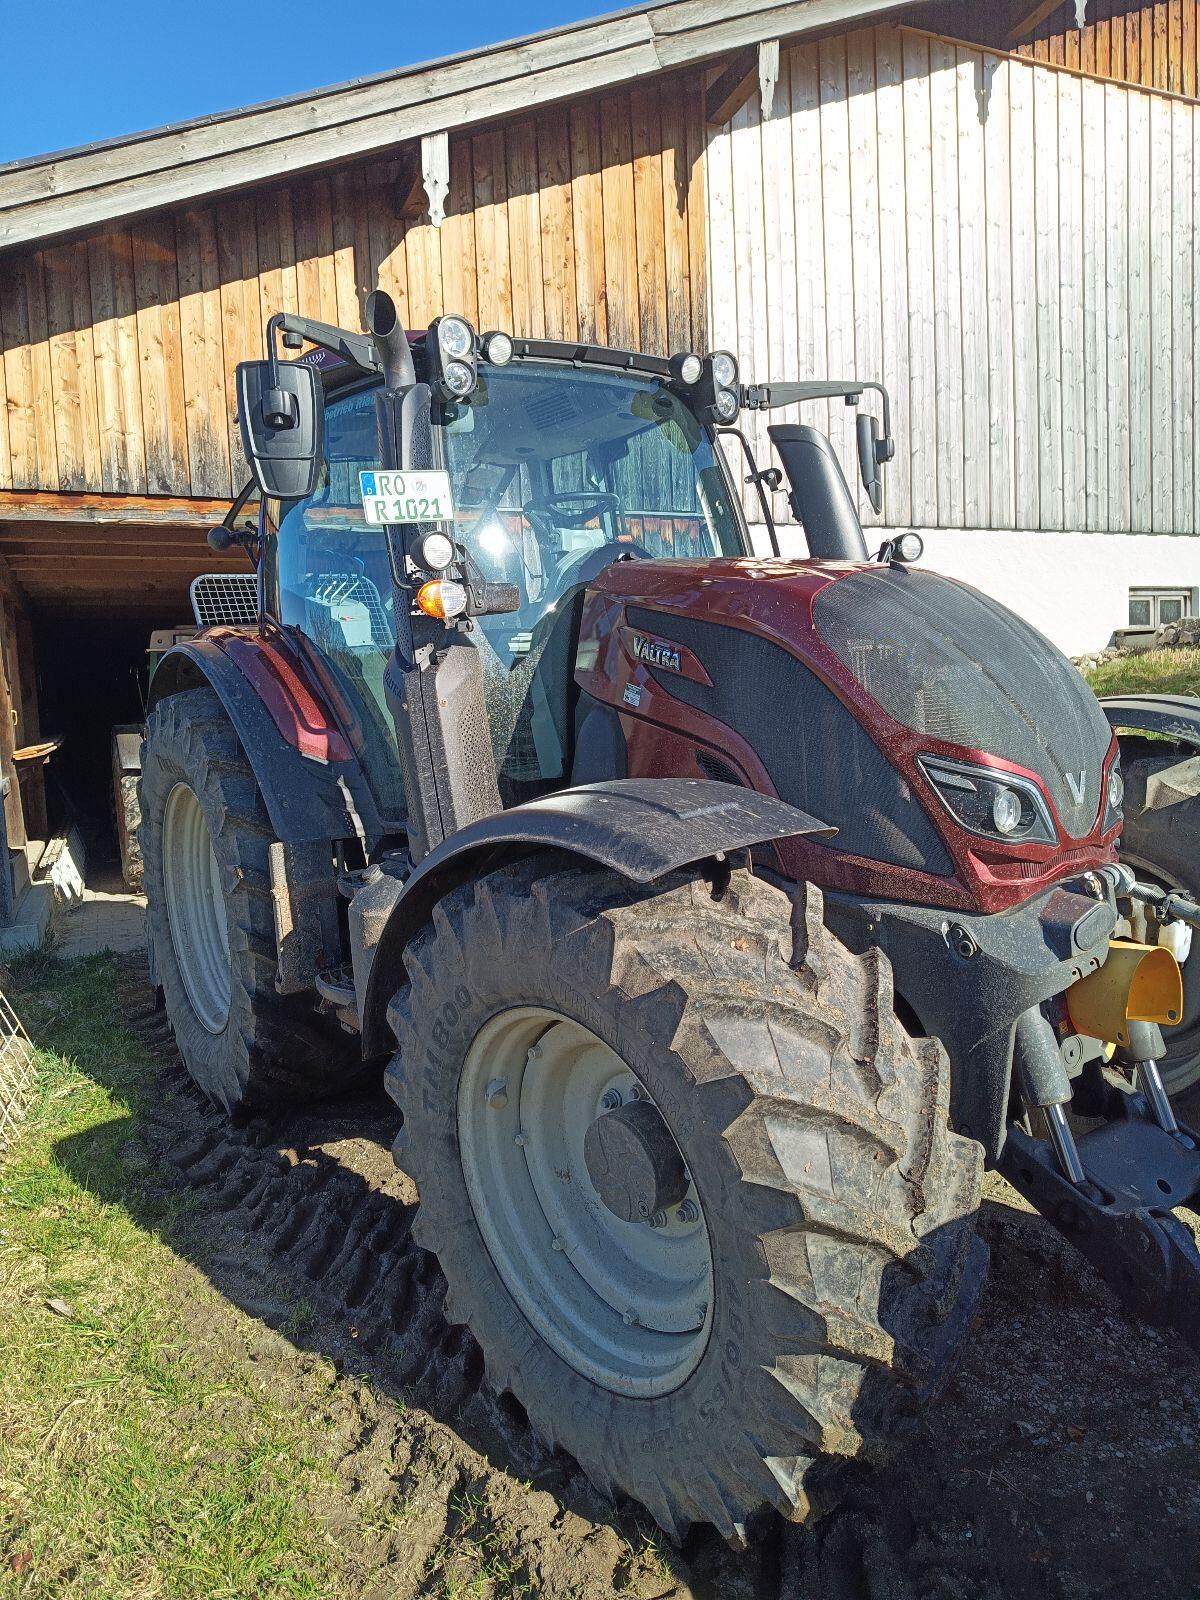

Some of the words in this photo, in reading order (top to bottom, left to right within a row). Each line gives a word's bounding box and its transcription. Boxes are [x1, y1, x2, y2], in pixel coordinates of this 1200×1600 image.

[366, 487, 373, 495] D
[378, 475, 406, 497] RO
[374, 500, 390, 521] R
[393, 498, 444, 520] 1021
[632, 635, 683, 673] VALTRA
[1065, 770, 1087, 807] V
